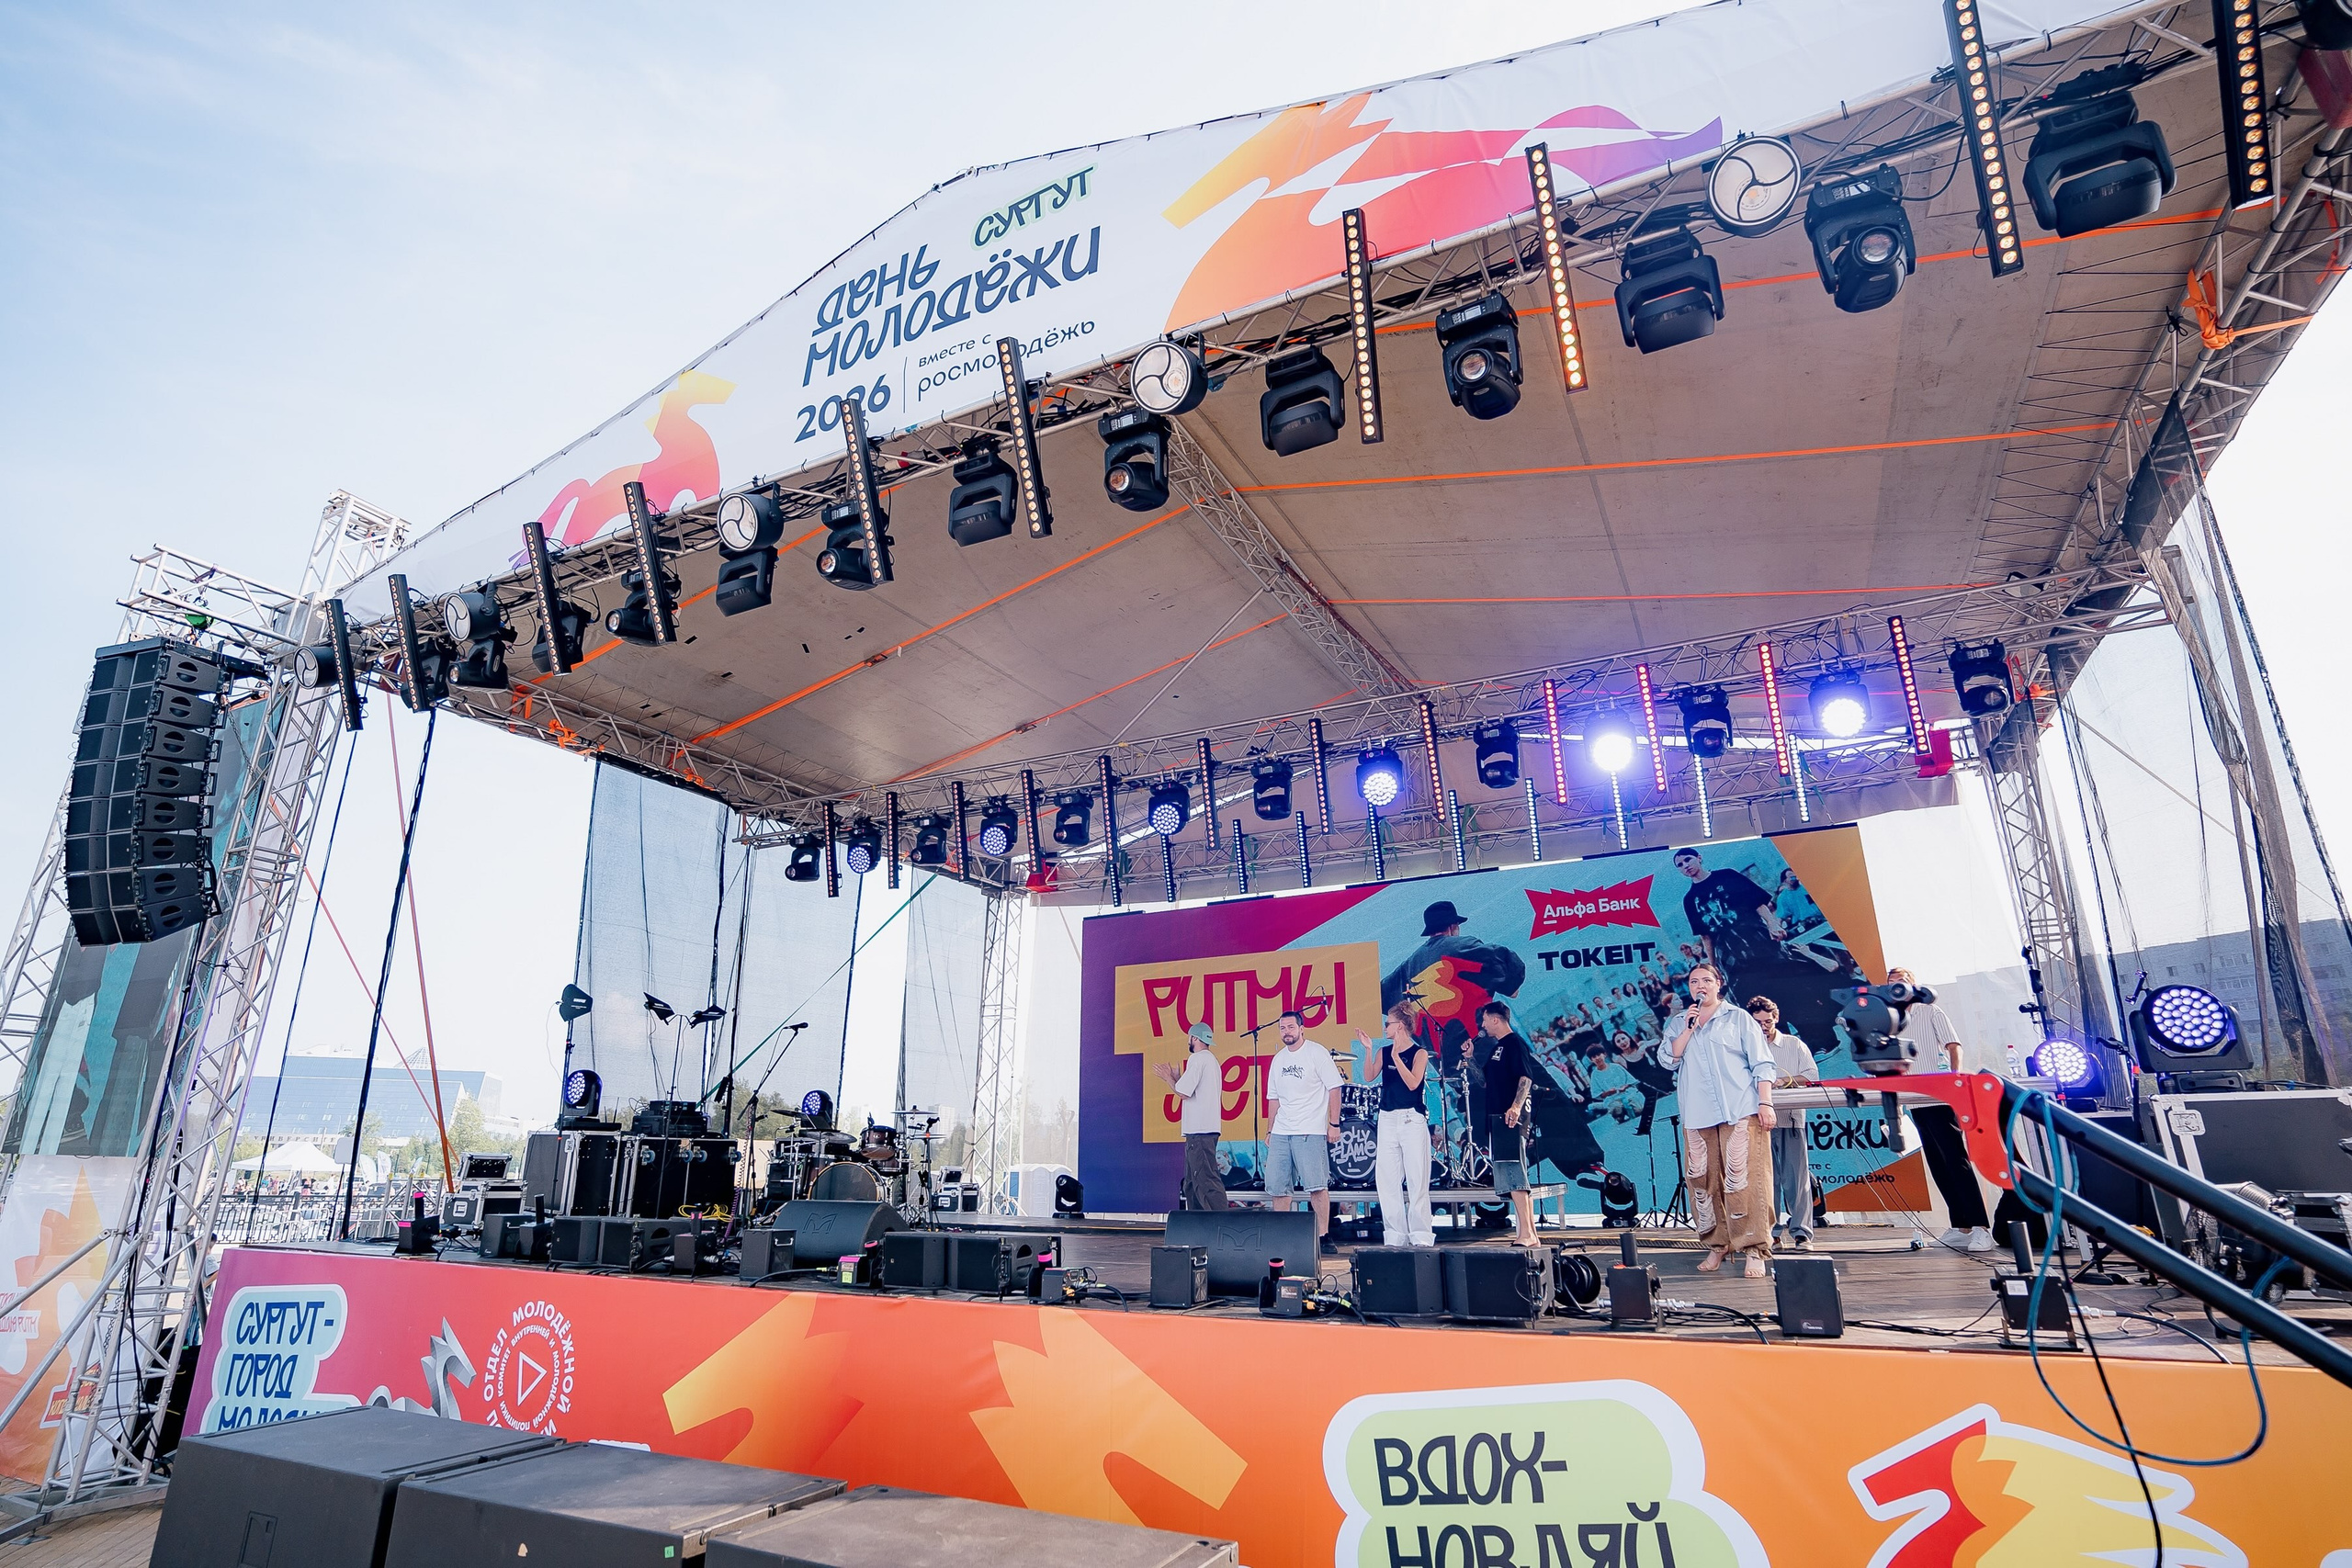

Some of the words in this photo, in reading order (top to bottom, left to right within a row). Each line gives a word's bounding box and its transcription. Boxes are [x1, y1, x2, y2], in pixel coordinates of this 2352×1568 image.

[975, 166, 1093, 246] СУРГУТ
[802, 226, 1101, 387] МОЛОДЁЖИ
[812, 244, 940, 336] ДЕНЬ
[919, 338, 975, 367] вместе
[982, 333, 991, 345] с
[919, 321, 1095, 401] росмоодёжь
[1544, 901, 1596, 920] Альфа
[1599, 897, 1641, 913] Банк
[1537, 942, 1656, 971] TOKEIT
[1143, 962, 1347, 1037] РИТМЫ
[1817, 1172, 1895, 1185] молодёжь
[483, 1327, 508, 1402] ОТДЕЛ
[512, 1300, 575, 1414] МОЛОДЁЖНОЙ
[511, 1324, 550, 1348] ВНУТРЕННЕЙ
[548, 1337, 556, 1348] И
[225, 1353, 299, 1399] ГОРОД
[497, 1347, 512, 1397] КОМИТЕТ
[500, 1400, 530, 1431] ПОЛИТИКИ
[1374, 1431, 1567, 1506] ВДОХ-
